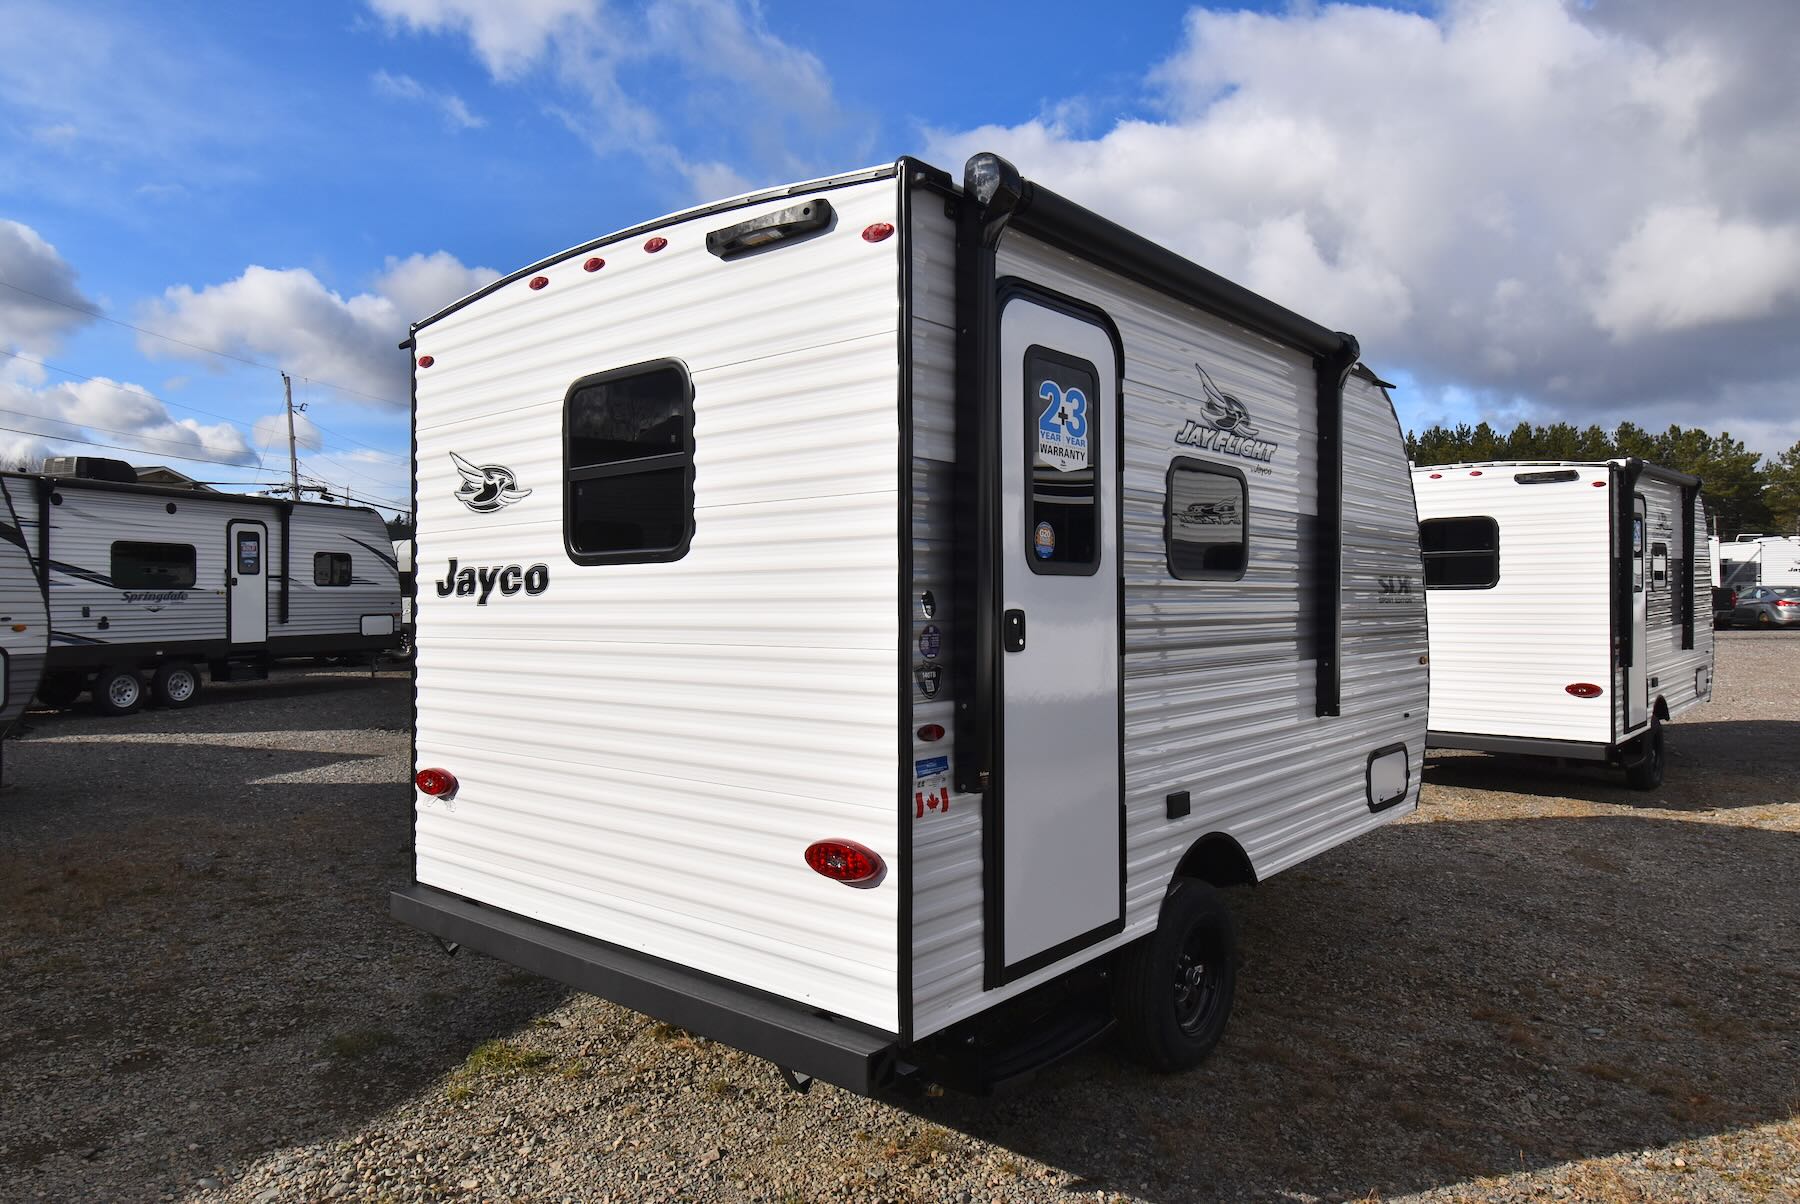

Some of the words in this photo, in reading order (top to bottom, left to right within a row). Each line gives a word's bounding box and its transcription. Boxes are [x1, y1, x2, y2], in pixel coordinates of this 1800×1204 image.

[1040, 430, 1061, 442] YEAR
[1066, 436, 1086, 447] YEAR
[1040, 443, 1086, 461] WARRANTY
[435, 556, 550, 606] Jayco
[121, 591, 189, 604] Springdale
